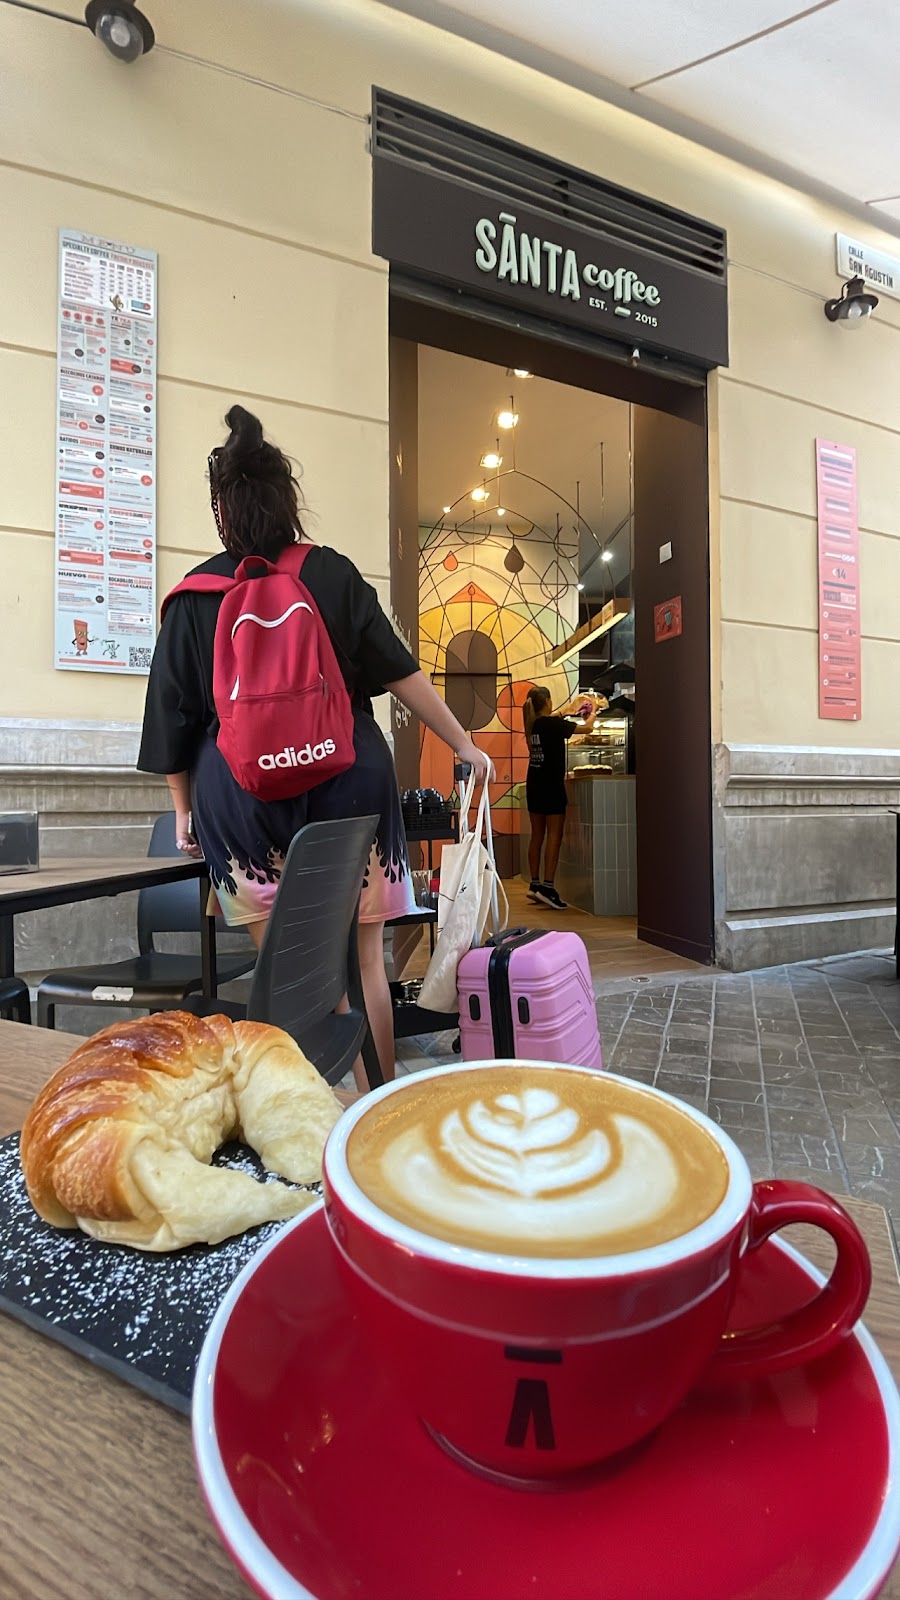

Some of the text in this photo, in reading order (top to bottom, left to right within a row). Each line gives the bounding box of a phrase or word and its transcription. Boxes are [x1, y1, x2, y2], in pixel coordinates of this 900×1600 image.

[848, 245, 864, 259] CALLE
[849, 257, 863, 275] SAN
[582, 263, 661, 307] coffee
[589, 297, 658, 328] EST. 2015
[58, 571, 87, 579] HUEVOS
[258, 738, 336, 770] adidas
